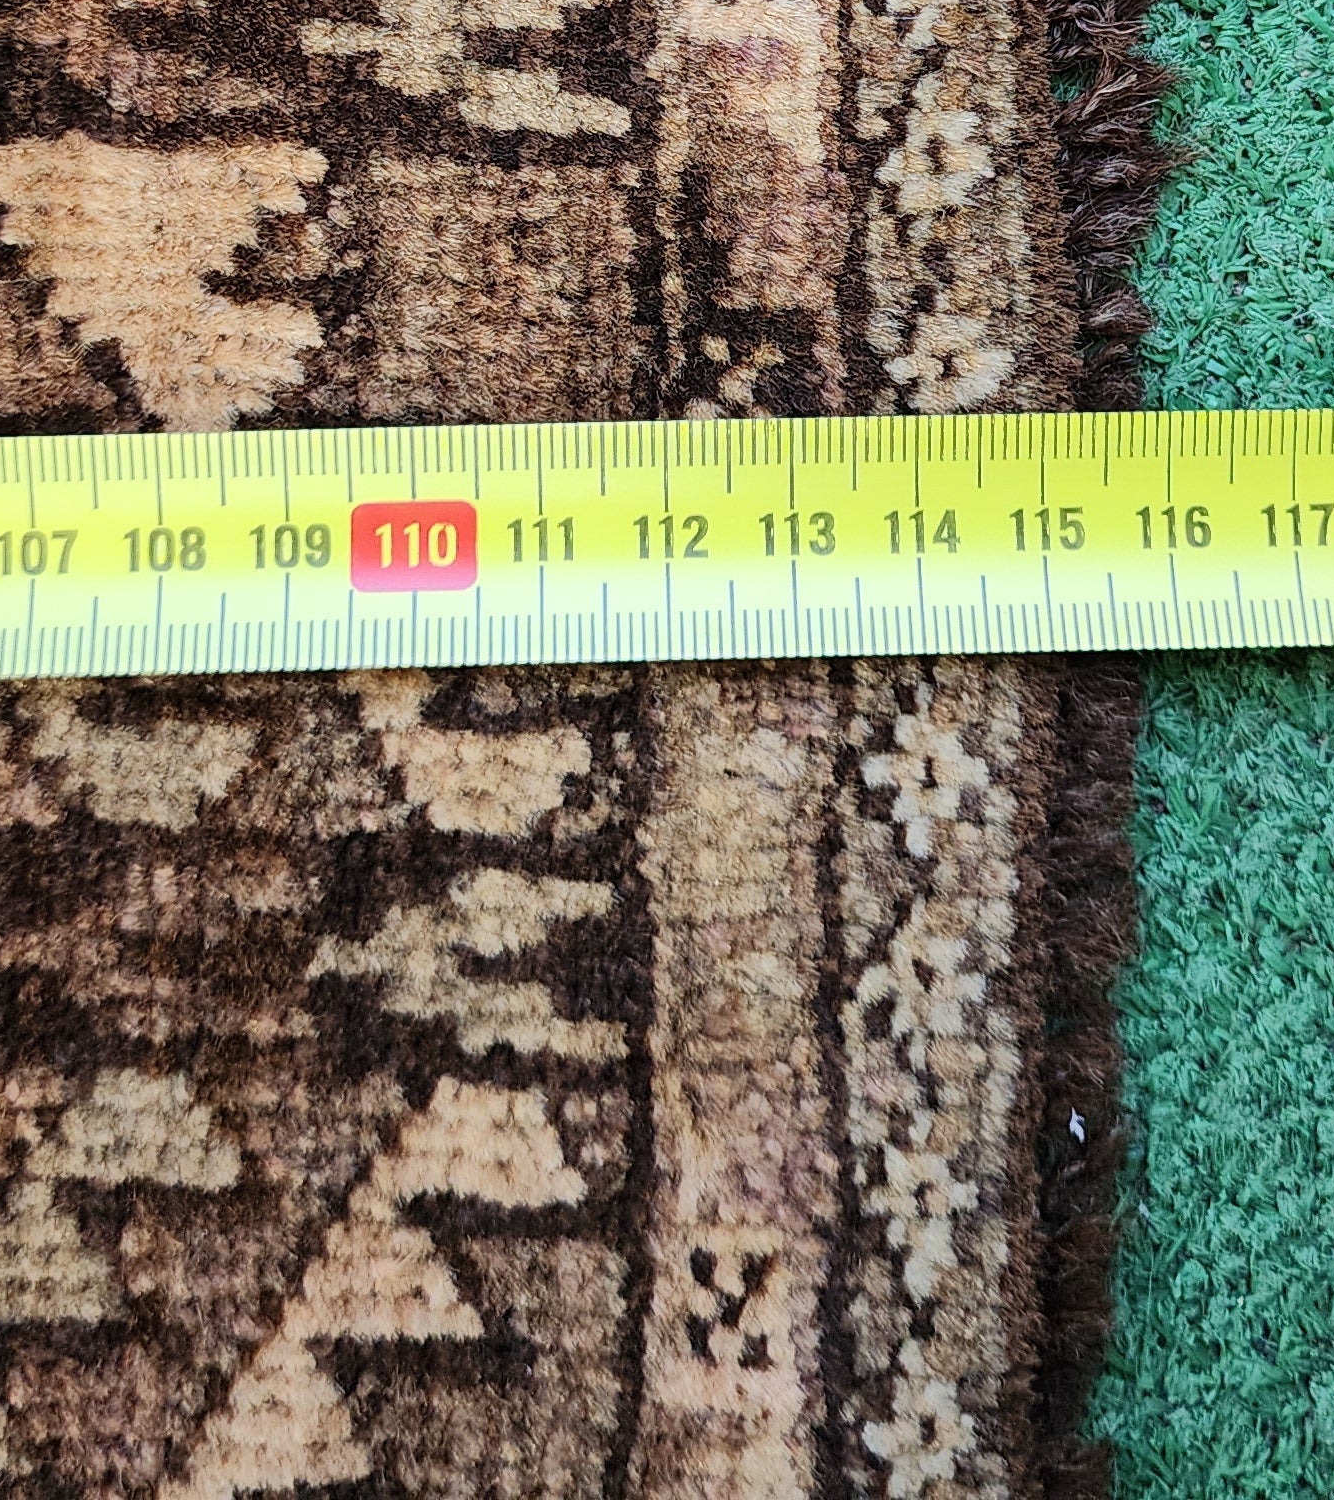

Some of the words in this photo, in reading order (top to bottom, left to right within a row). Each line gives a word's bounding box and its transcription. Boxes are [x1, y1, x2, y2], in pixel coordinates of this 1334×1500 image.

[123, 526, 207, 573] 108
[248, 523, 333, 570] 109
[374, 521, 458, 569] 110
[507, 516, 575, 563] 111
[633, 513, 710, 561] 112
[759, 511, 836, 558] 113
[884, 508, 962, 555] 114
[1009, 505, 1086, 552] 115
[1135, 505, 1212, 549] 116
[1260, 503, 1333, 546] 117
